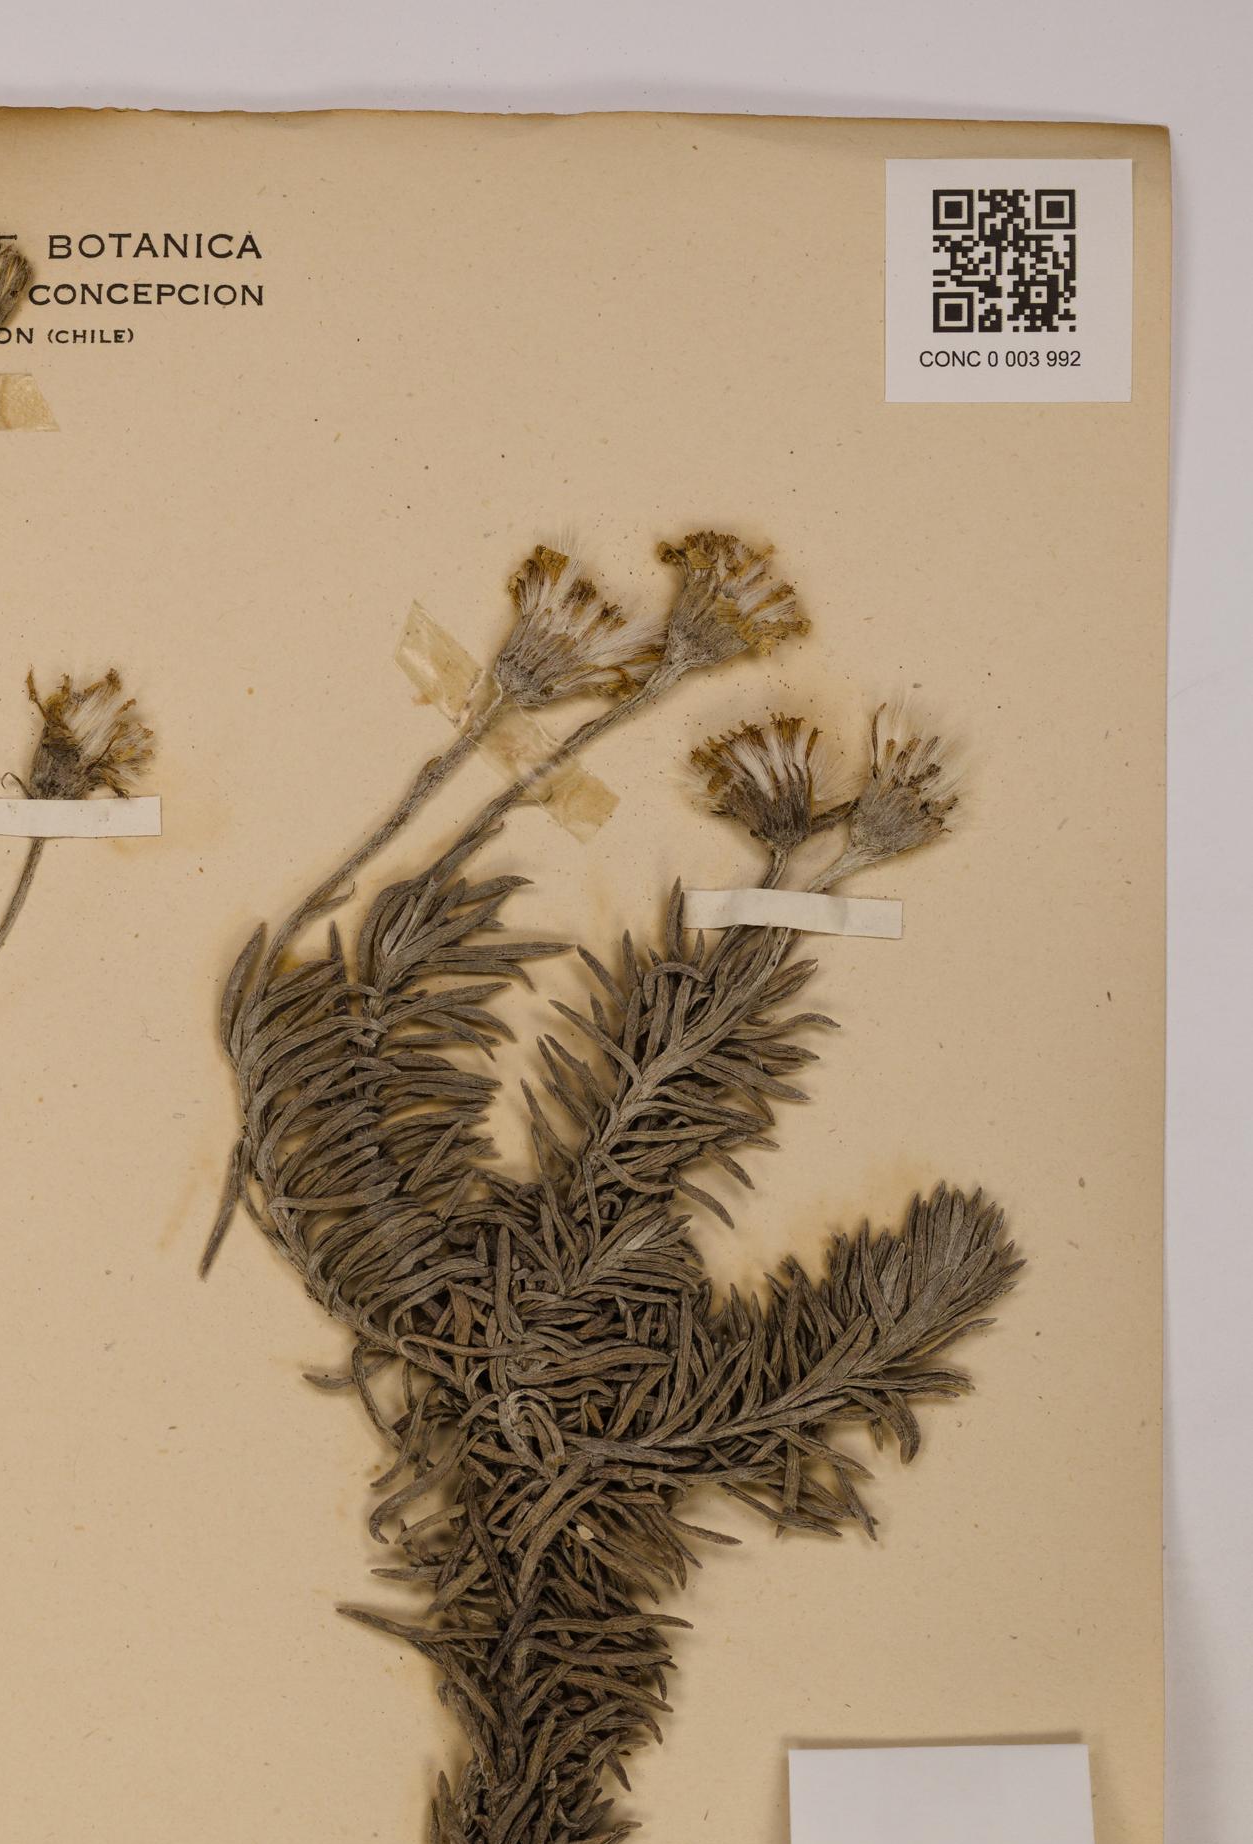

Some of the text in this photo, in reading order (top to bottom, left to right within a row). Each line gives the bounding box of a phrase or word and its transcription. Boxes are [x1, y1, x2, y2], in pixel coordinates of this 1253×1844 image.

[48, 231, 263, 260] BOTANICA
[28, 283, 264, 306] CONCEPCION
[47, 328, 135, 345] (CHILE)
[919, 350, 1081, 367] CONC 0 003 992
